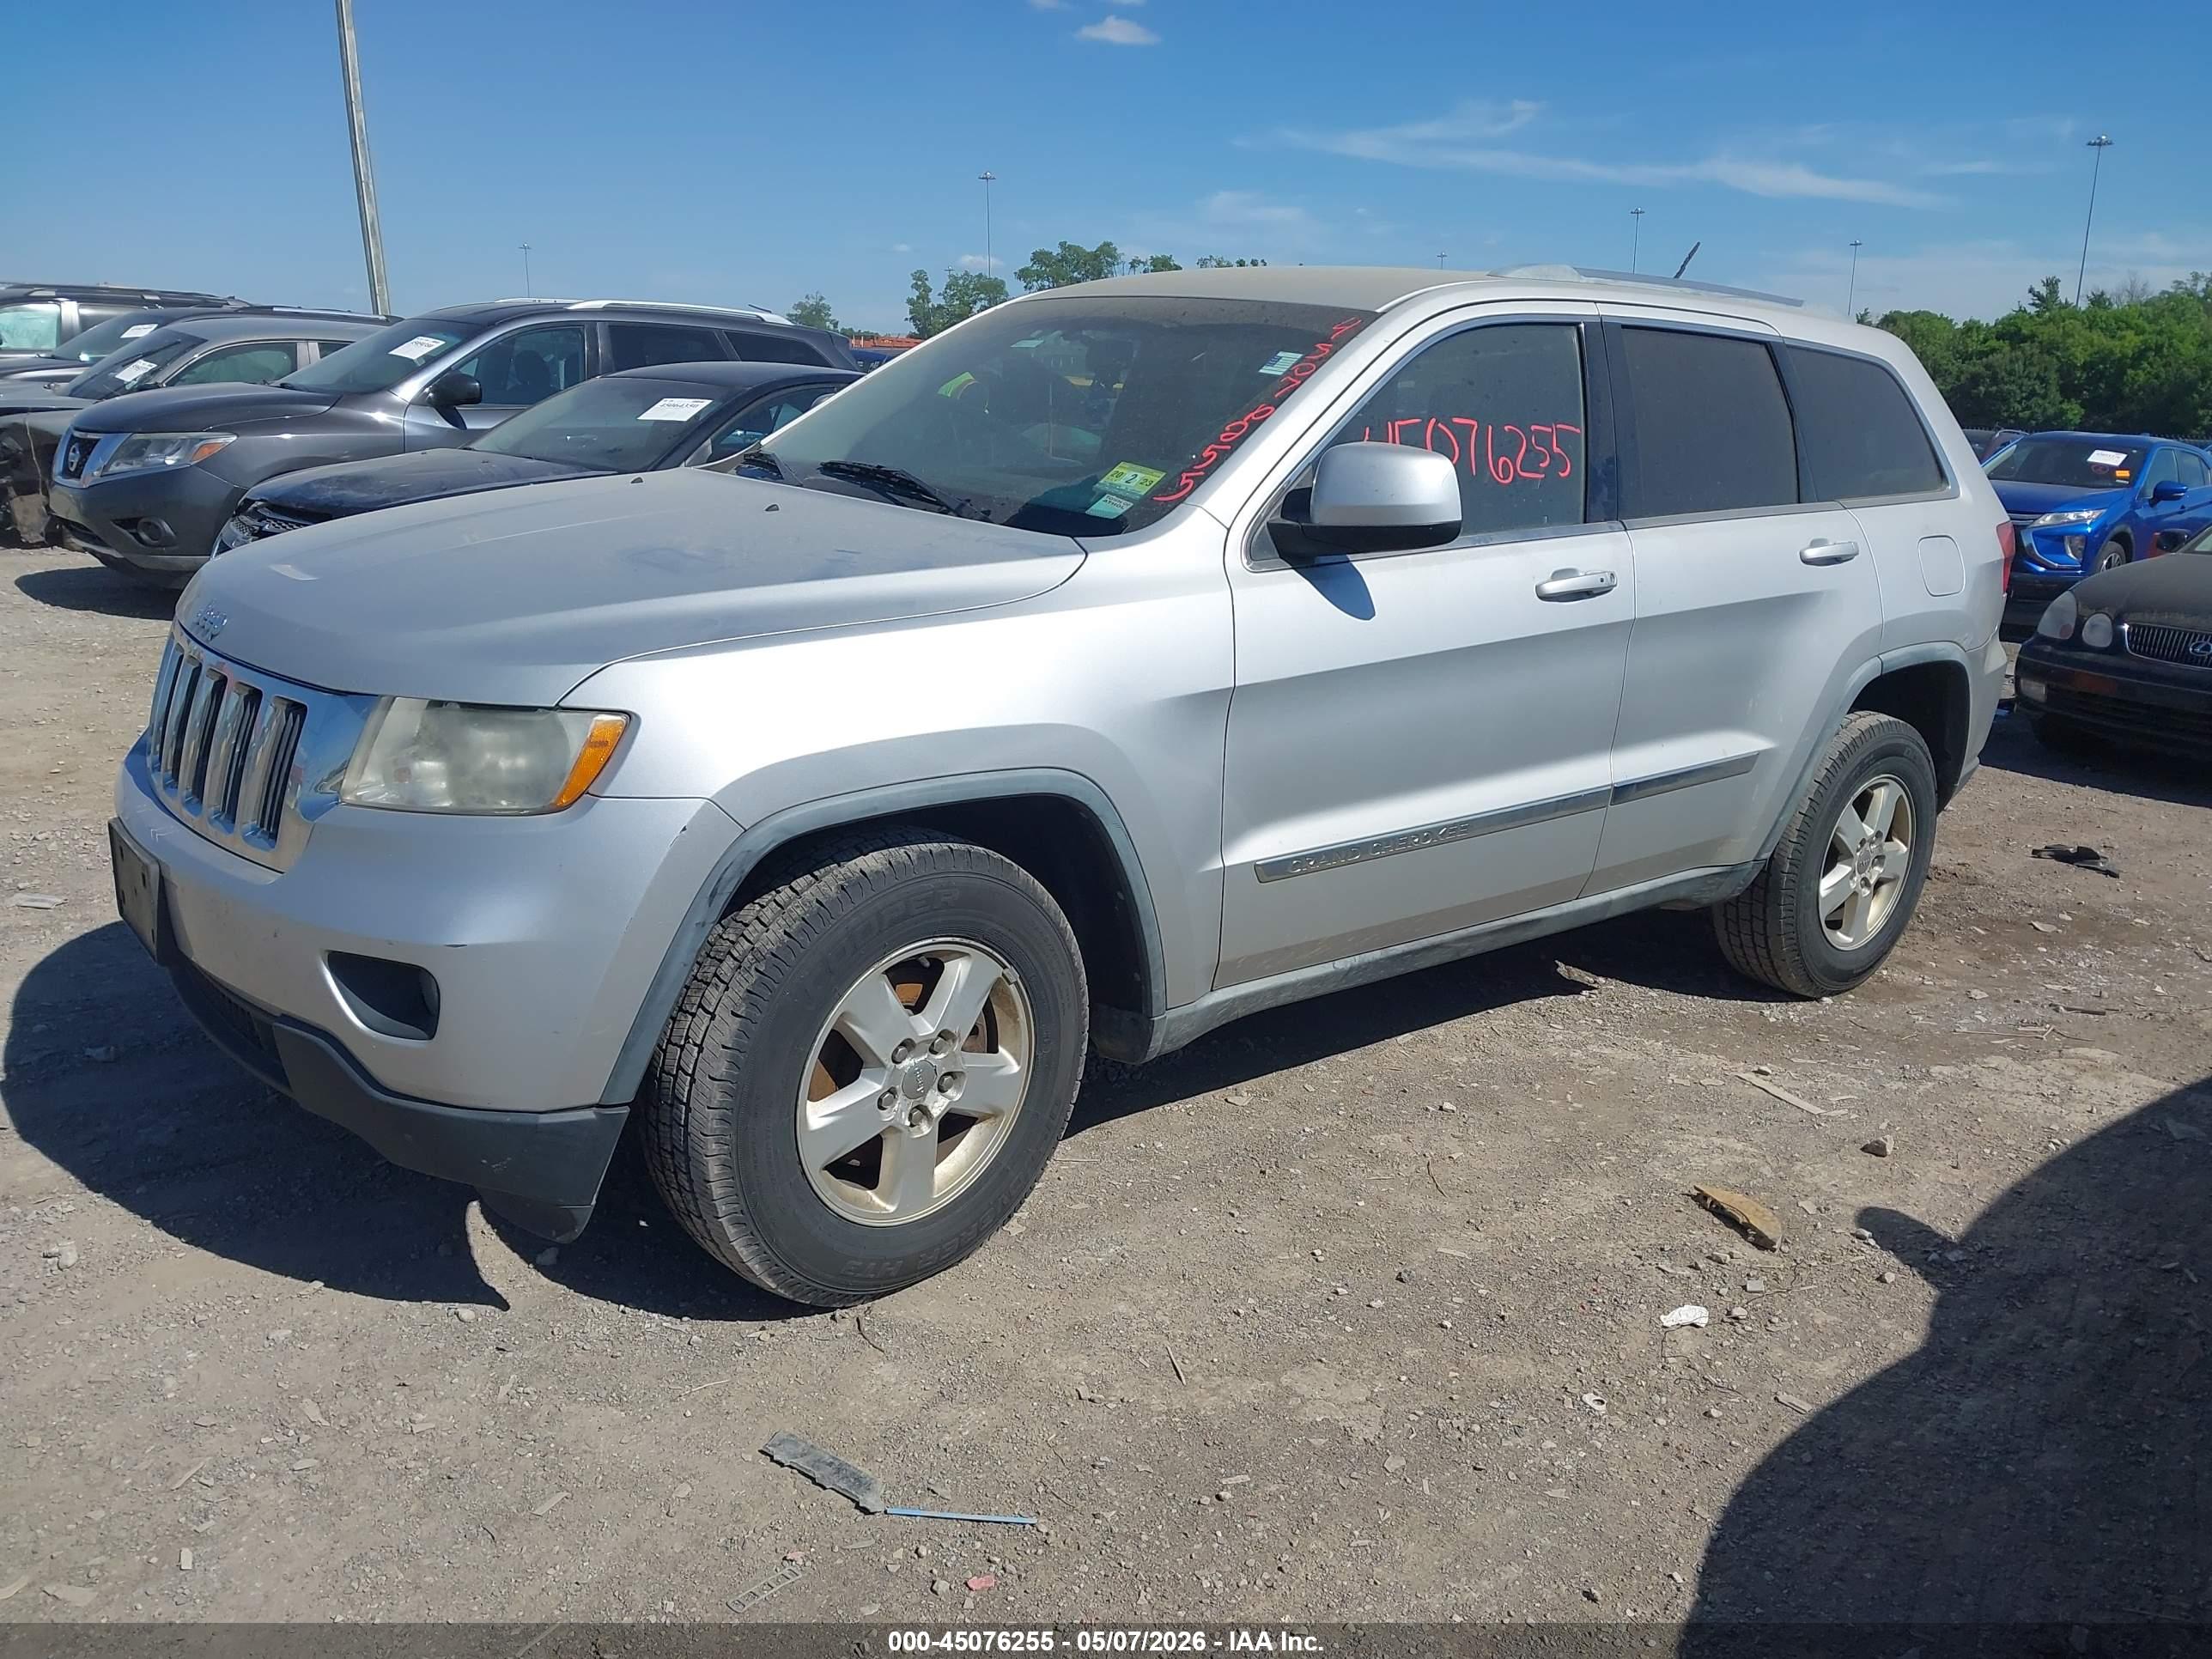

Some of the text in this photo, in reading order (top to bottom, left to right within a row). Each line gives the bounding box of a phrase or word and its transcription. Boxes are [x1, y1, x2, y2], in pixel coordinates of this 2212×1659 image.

[1125, 473, 1138, 484] 2
[1139, 477, 1154, 487] 23
[1289, 823, 1470, 874] GRAND CHEROKEE
